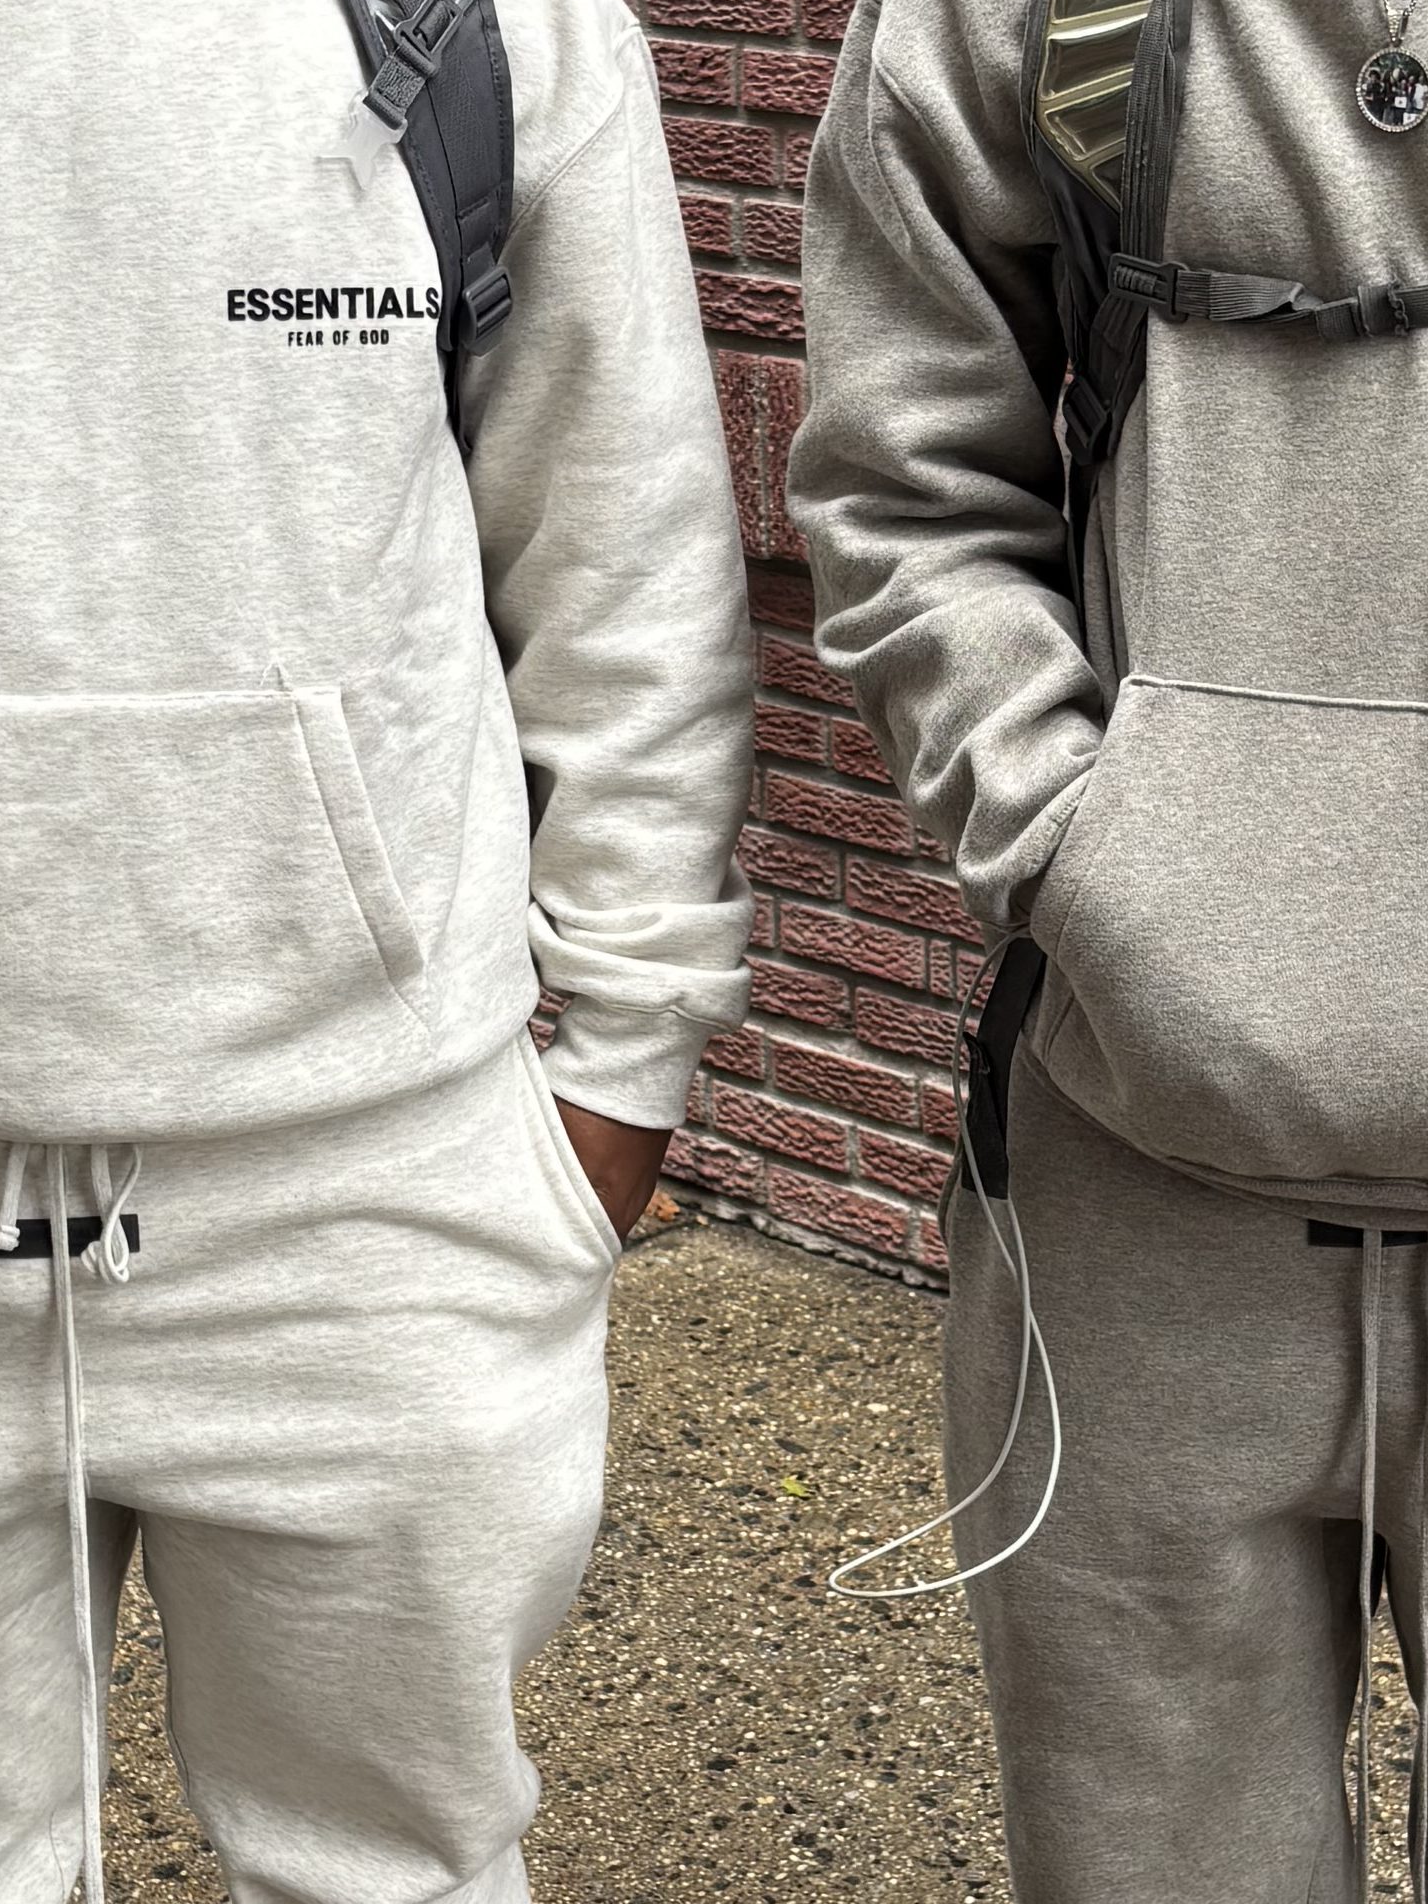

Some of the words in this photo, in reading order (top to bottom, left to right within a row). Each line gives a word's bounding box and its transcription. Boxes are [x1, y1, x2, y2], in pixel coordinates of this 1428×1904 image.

[227, 287, 441, 321] ESSENTIALS
[287, 330, 324, 346] FEAR
[332, 329, 351, 345] OF
[359, 328, 390, 345] GOD
